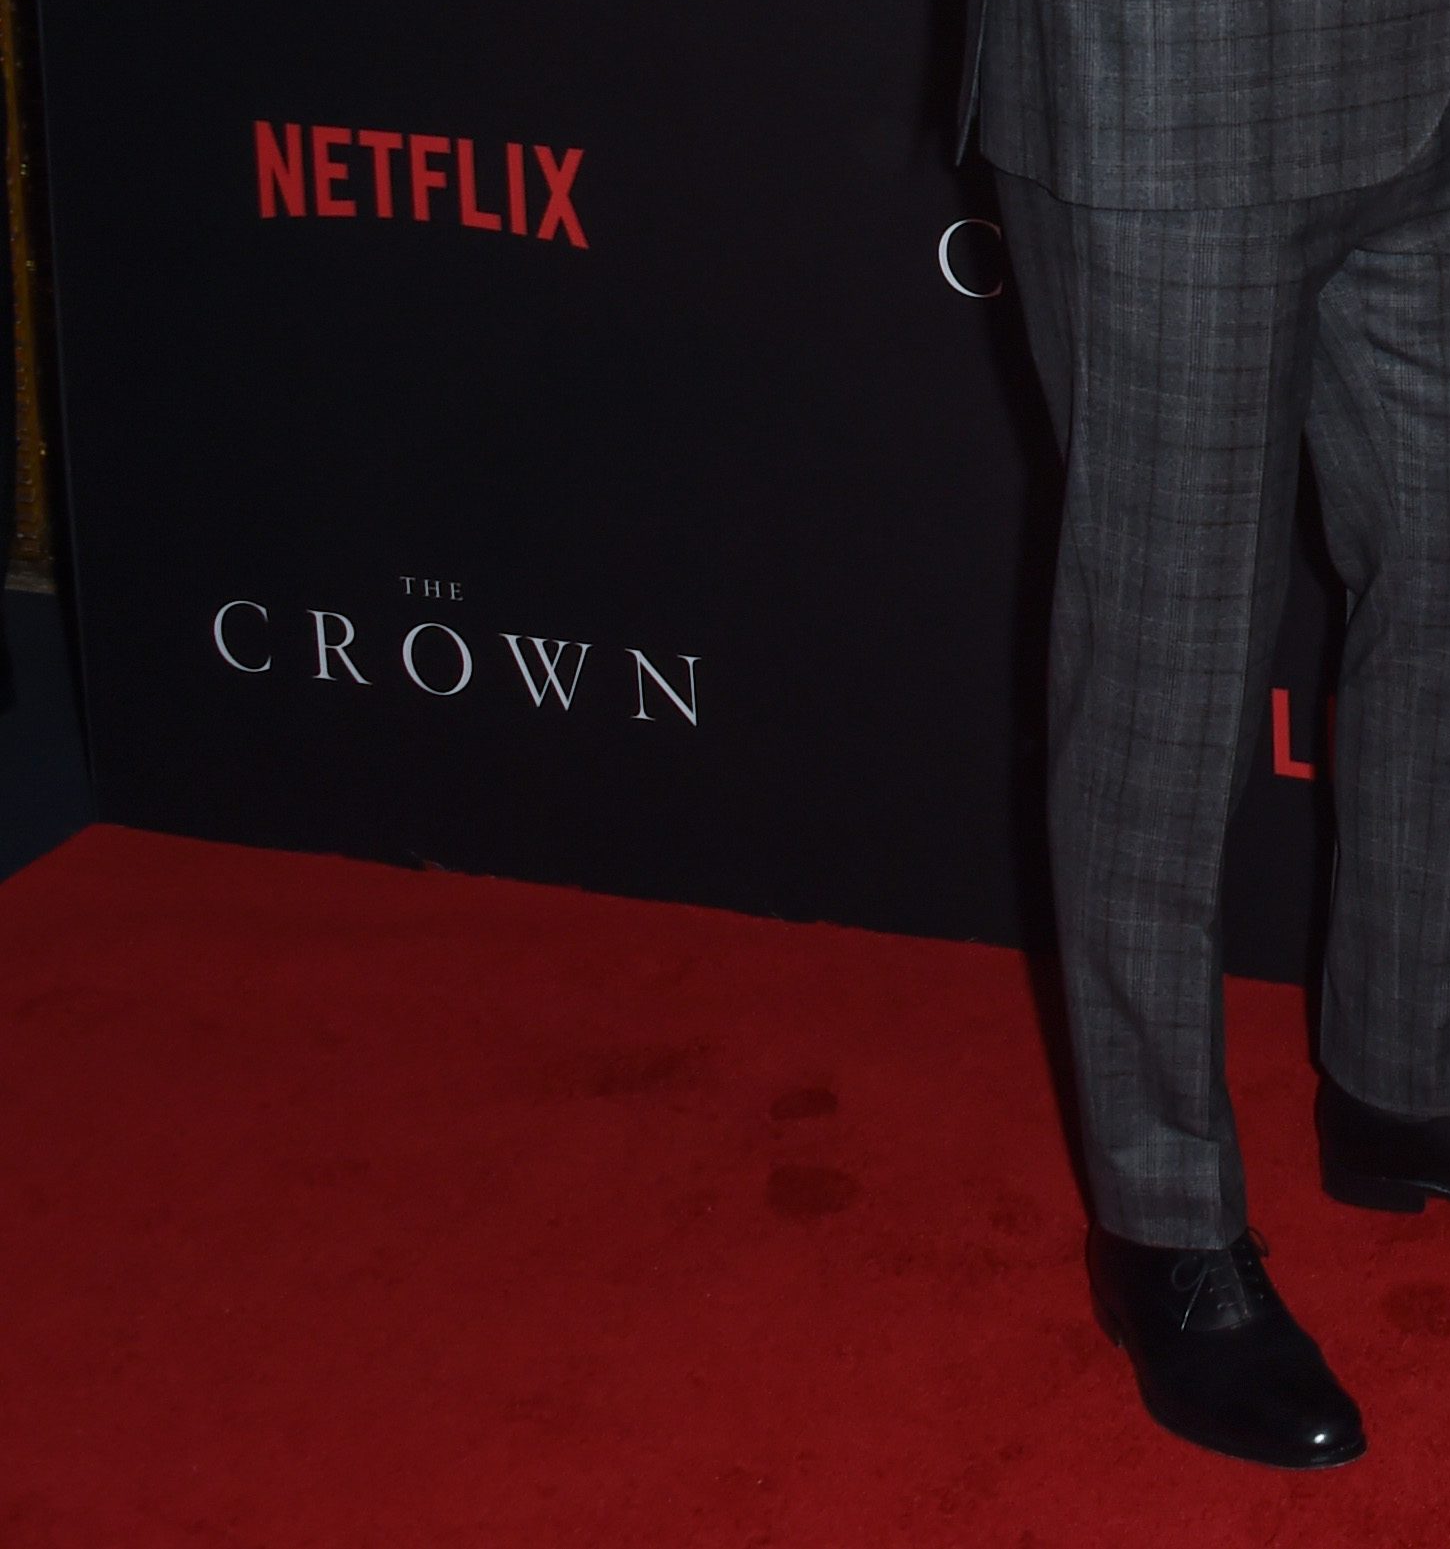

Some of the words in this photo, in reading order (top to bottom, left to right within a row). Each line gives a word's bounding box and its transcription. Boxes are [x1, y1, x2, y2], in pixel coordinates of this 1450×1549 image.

[254, 120, 589, 249] NETFLIX
[400, 576, 464, 601] THE
[213, 600, 702, 727] CROWN
